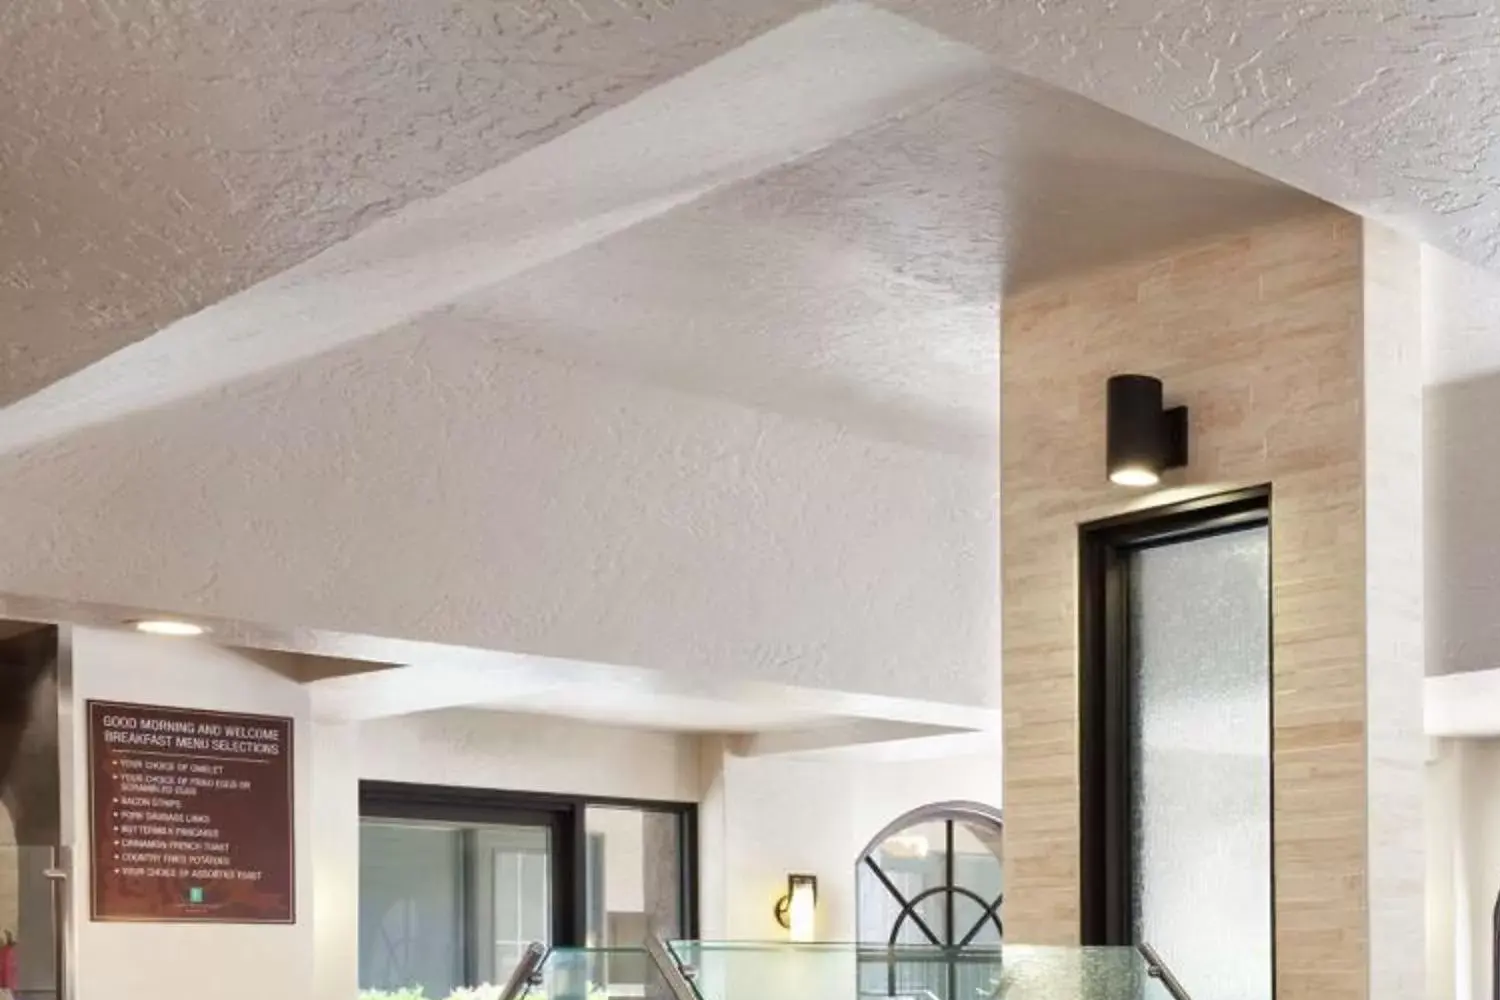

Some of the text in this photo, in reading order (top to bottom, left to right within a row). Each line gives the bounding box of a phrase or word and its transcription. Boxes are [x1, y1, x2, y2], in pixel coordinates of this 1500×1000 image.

[104, 716, 280, 741] GOOD MORNING AND WELCOME
[104, 730, 279, 755] BREAKFAST MENU SELECTIONS
